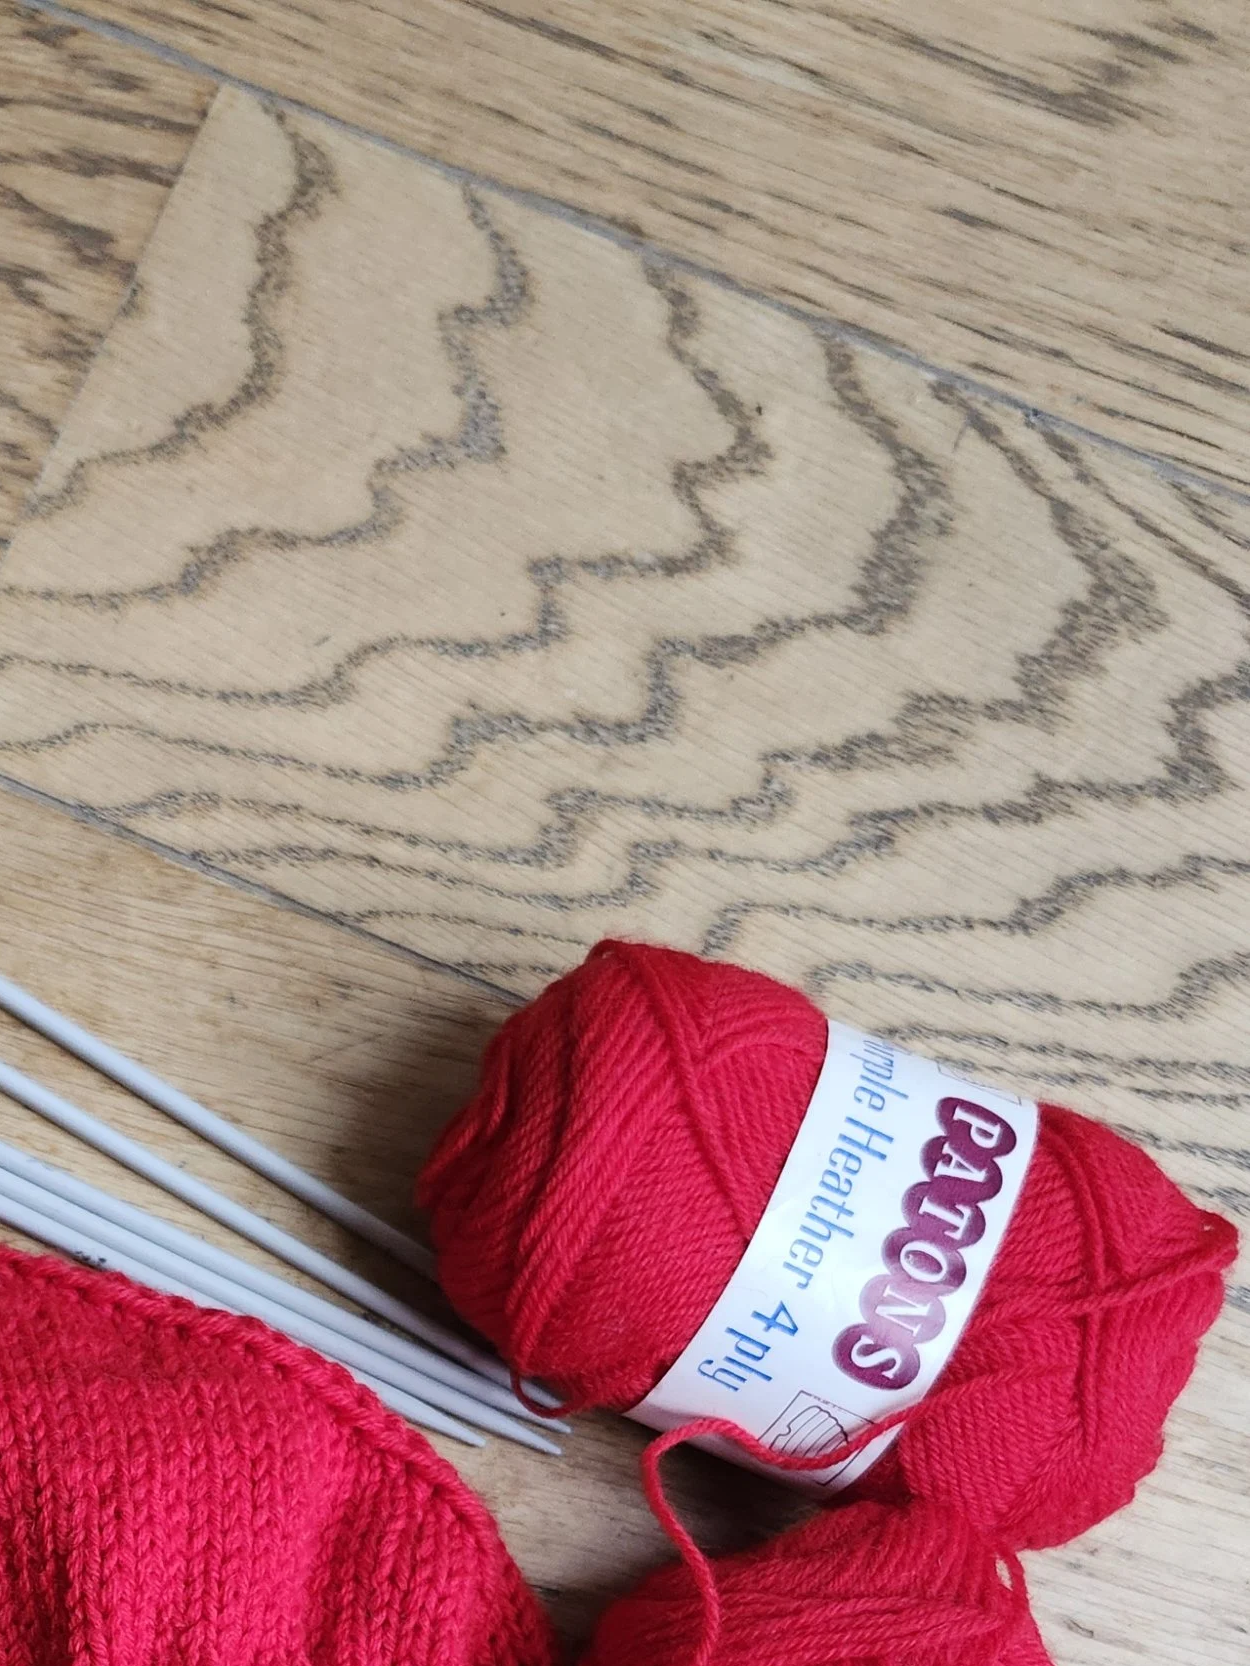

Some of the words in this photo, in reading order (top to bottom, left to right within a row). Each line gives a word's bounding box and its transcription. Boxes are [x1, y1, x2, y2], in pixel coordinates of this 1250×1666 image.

[849, 1039, 909, 1112] urple
[783, 1117, 895, 1291] Heather
[846, 1101, 1005, 1384] PATONS
[751, 1300, 799, 1337] 4
[697, 1327, 773, 1392] ply
